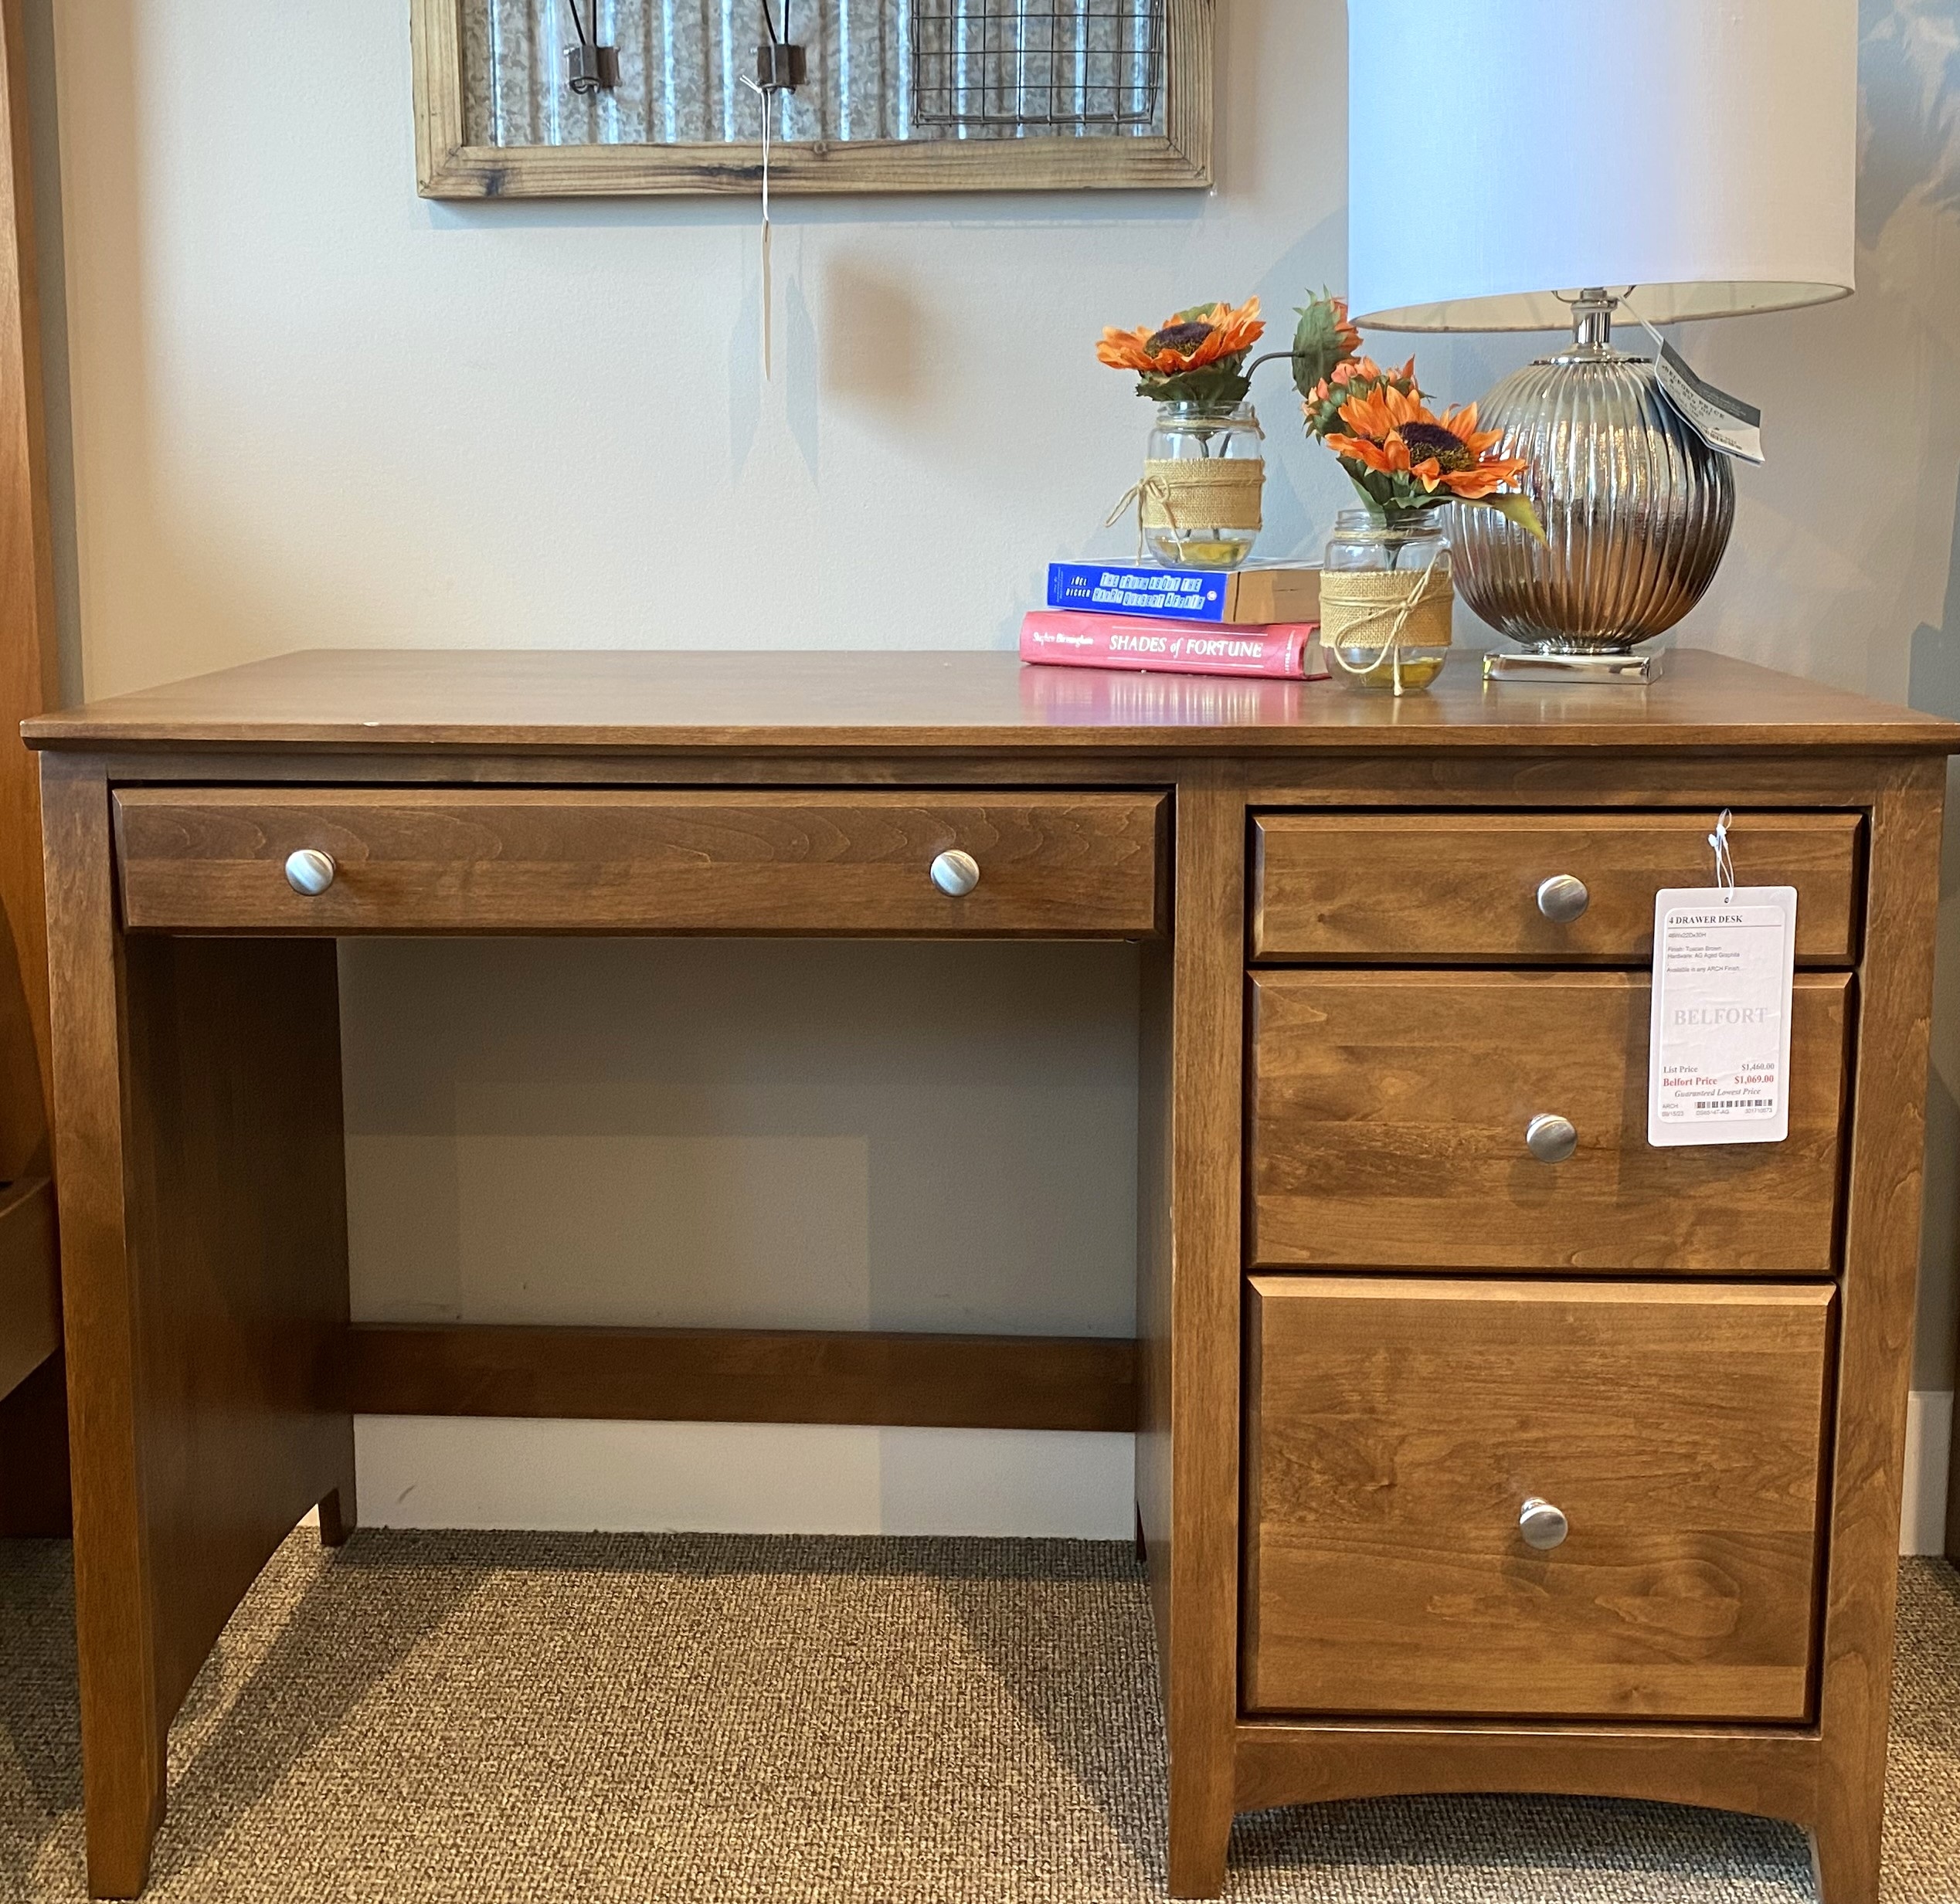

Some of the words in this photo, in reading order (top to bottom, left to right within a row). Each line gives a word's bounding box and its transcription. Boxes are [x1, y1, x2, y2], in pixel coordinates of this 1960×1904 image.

[1100, 572, 1119, 587] THE
[1119, 575, 1148, 590] TRUTH
[1148, 575, 1180, 592] ABOUT
[1180, 578, 1202, 592] THE
[1092, 588, 1124, 604] HARRY
[1123, 592, 1164, 608] QUEBERT
[1164, 592, 1205, 609] AFFAIR
[1109, 635, 1167, 653] SHADES
[1170, 637, 1184, 659] of
[1186, 639, 1264, 657] FORTUNE
[1676, 915, 1717, 925] DRAWER
[1718, 915, 1744, 924] DESK
[1674, 1007, 1768, 1026] BELFORT
[1741, 1063, 1775, 1071] $1,460.00
[1663, 1078, 1693, 1087] Belfort
[1695, 1077, 1718, 1085] Price
[1734, 1074, 1775, 1084] $1,069.00
[1674, 1089, 1716, 1098] Guaranteed
[1717, 1088, 1741, 1096] Lowest
